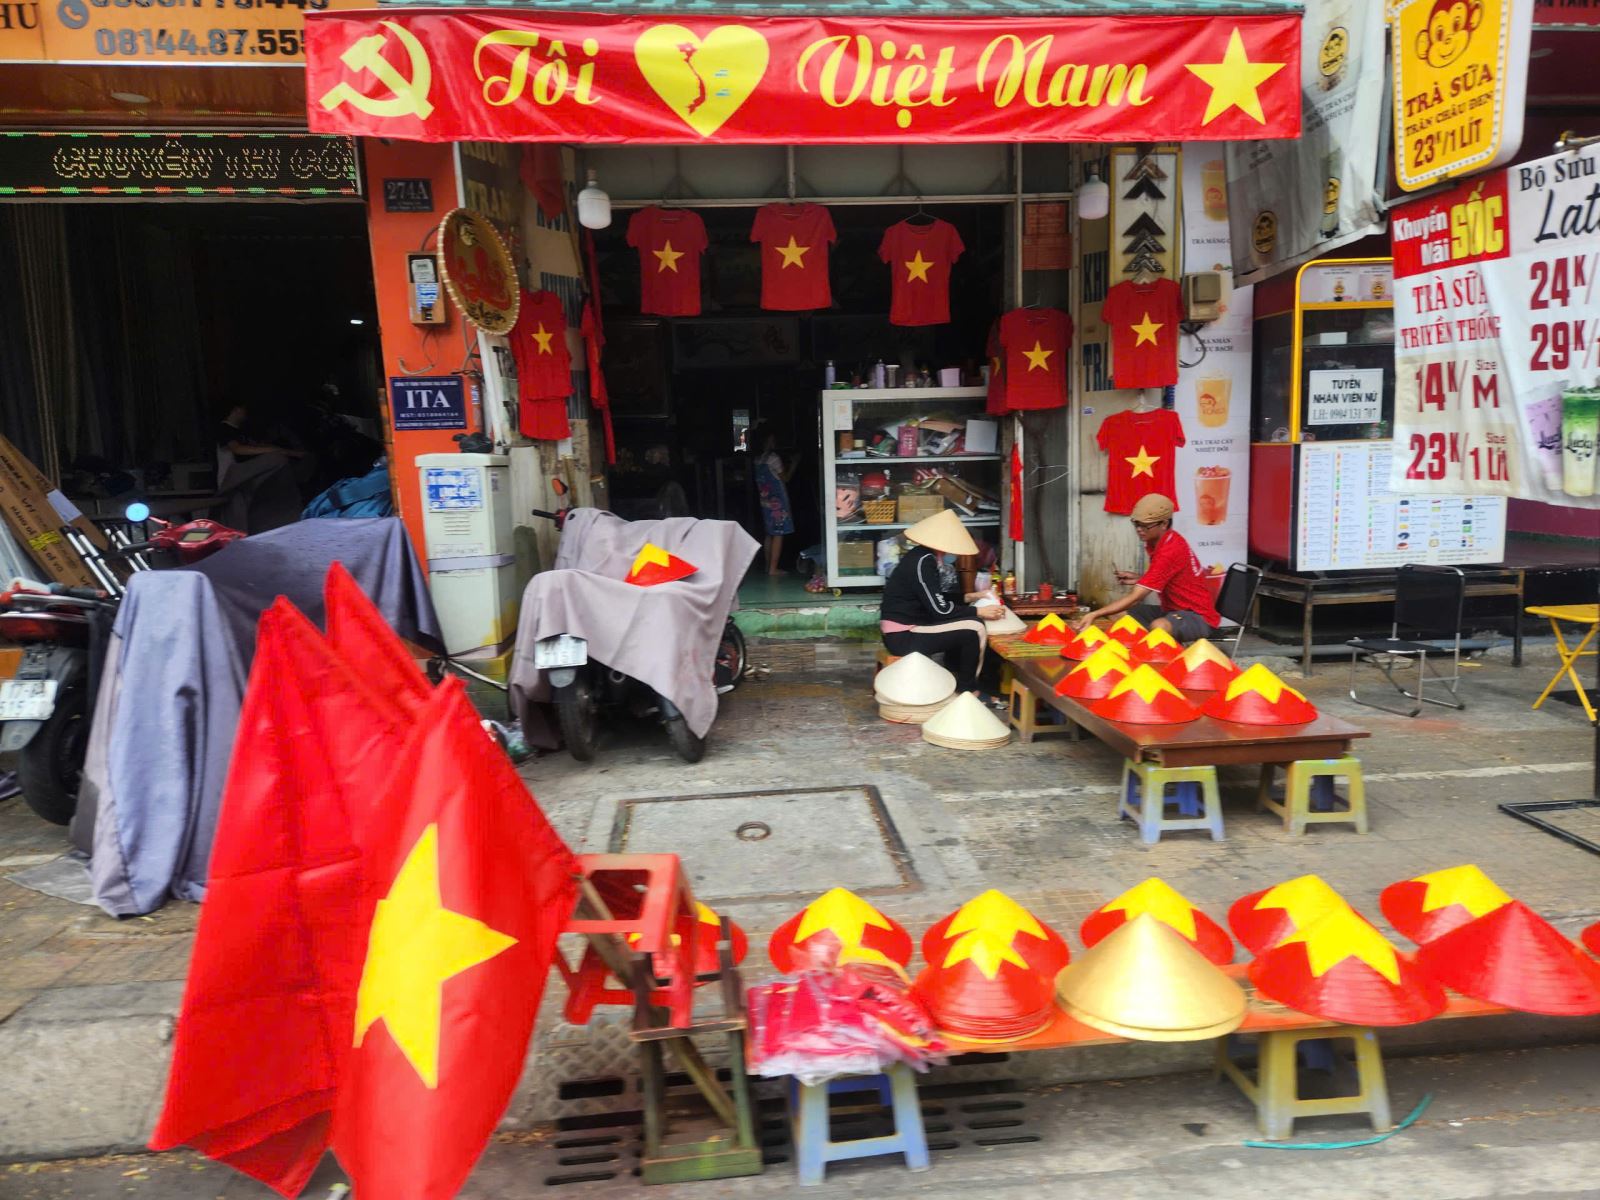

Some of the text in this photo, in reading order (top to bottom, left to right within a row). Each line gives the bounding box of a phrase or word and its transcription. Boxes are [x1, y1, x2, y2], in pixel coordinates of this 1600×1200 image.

[474, 29, 1153, 128] Tôi Việt Nam
[1406, 63, 1493, 118] TRÀ SỮA
[1519, 156, 1596, 191] Bộ Sưu
[1393, 204, 1448, 242] Khuyến
[1451, 181, 1504, 260] SỐC
[1534, 180, 1600, 244] Lat
[405, 390, 450, 408] ITA
